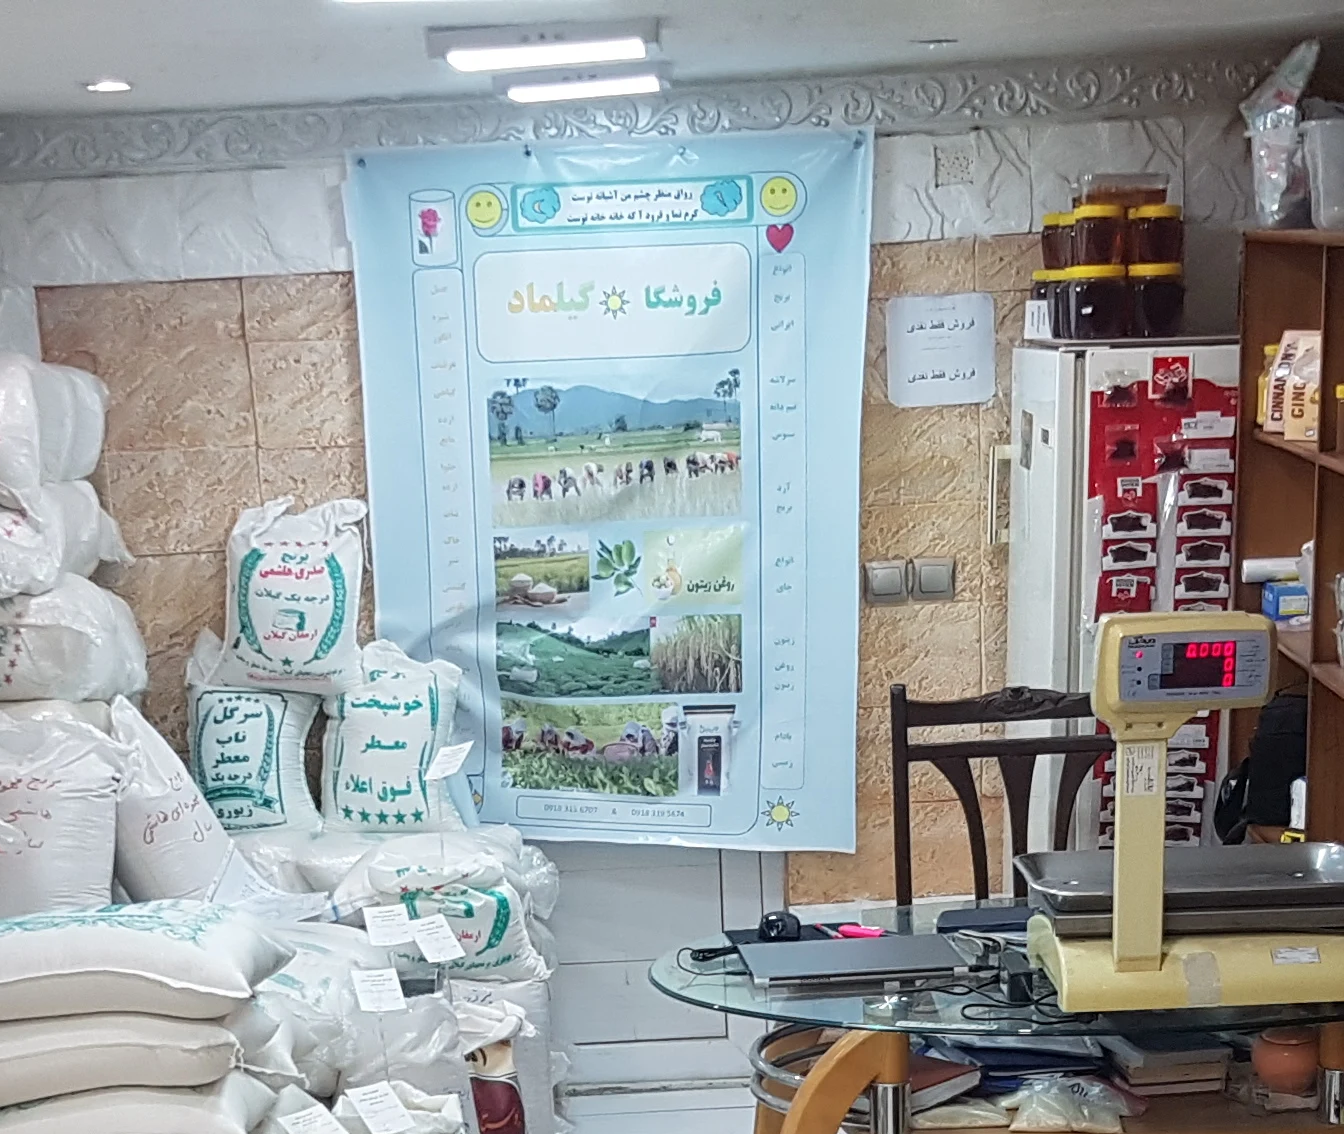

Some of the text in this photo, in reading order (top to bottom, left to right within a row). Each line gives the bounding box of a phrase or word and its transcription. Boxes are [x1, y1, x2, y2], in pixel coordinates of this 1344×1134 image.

[906, 316, 975, 333] فروش فقط نقدی
[907, 367, 976, 383] فروش فقط نقدی
[295, 564, 325, 581] صدری
[687, 576, 736, 593] روغن زیتون
[216, 731, 247, 746] ناب
[361, 734, 408, 753] معطر
[211, 752, 251, 769] معطر
[377, 775, 413, 802] فوق
